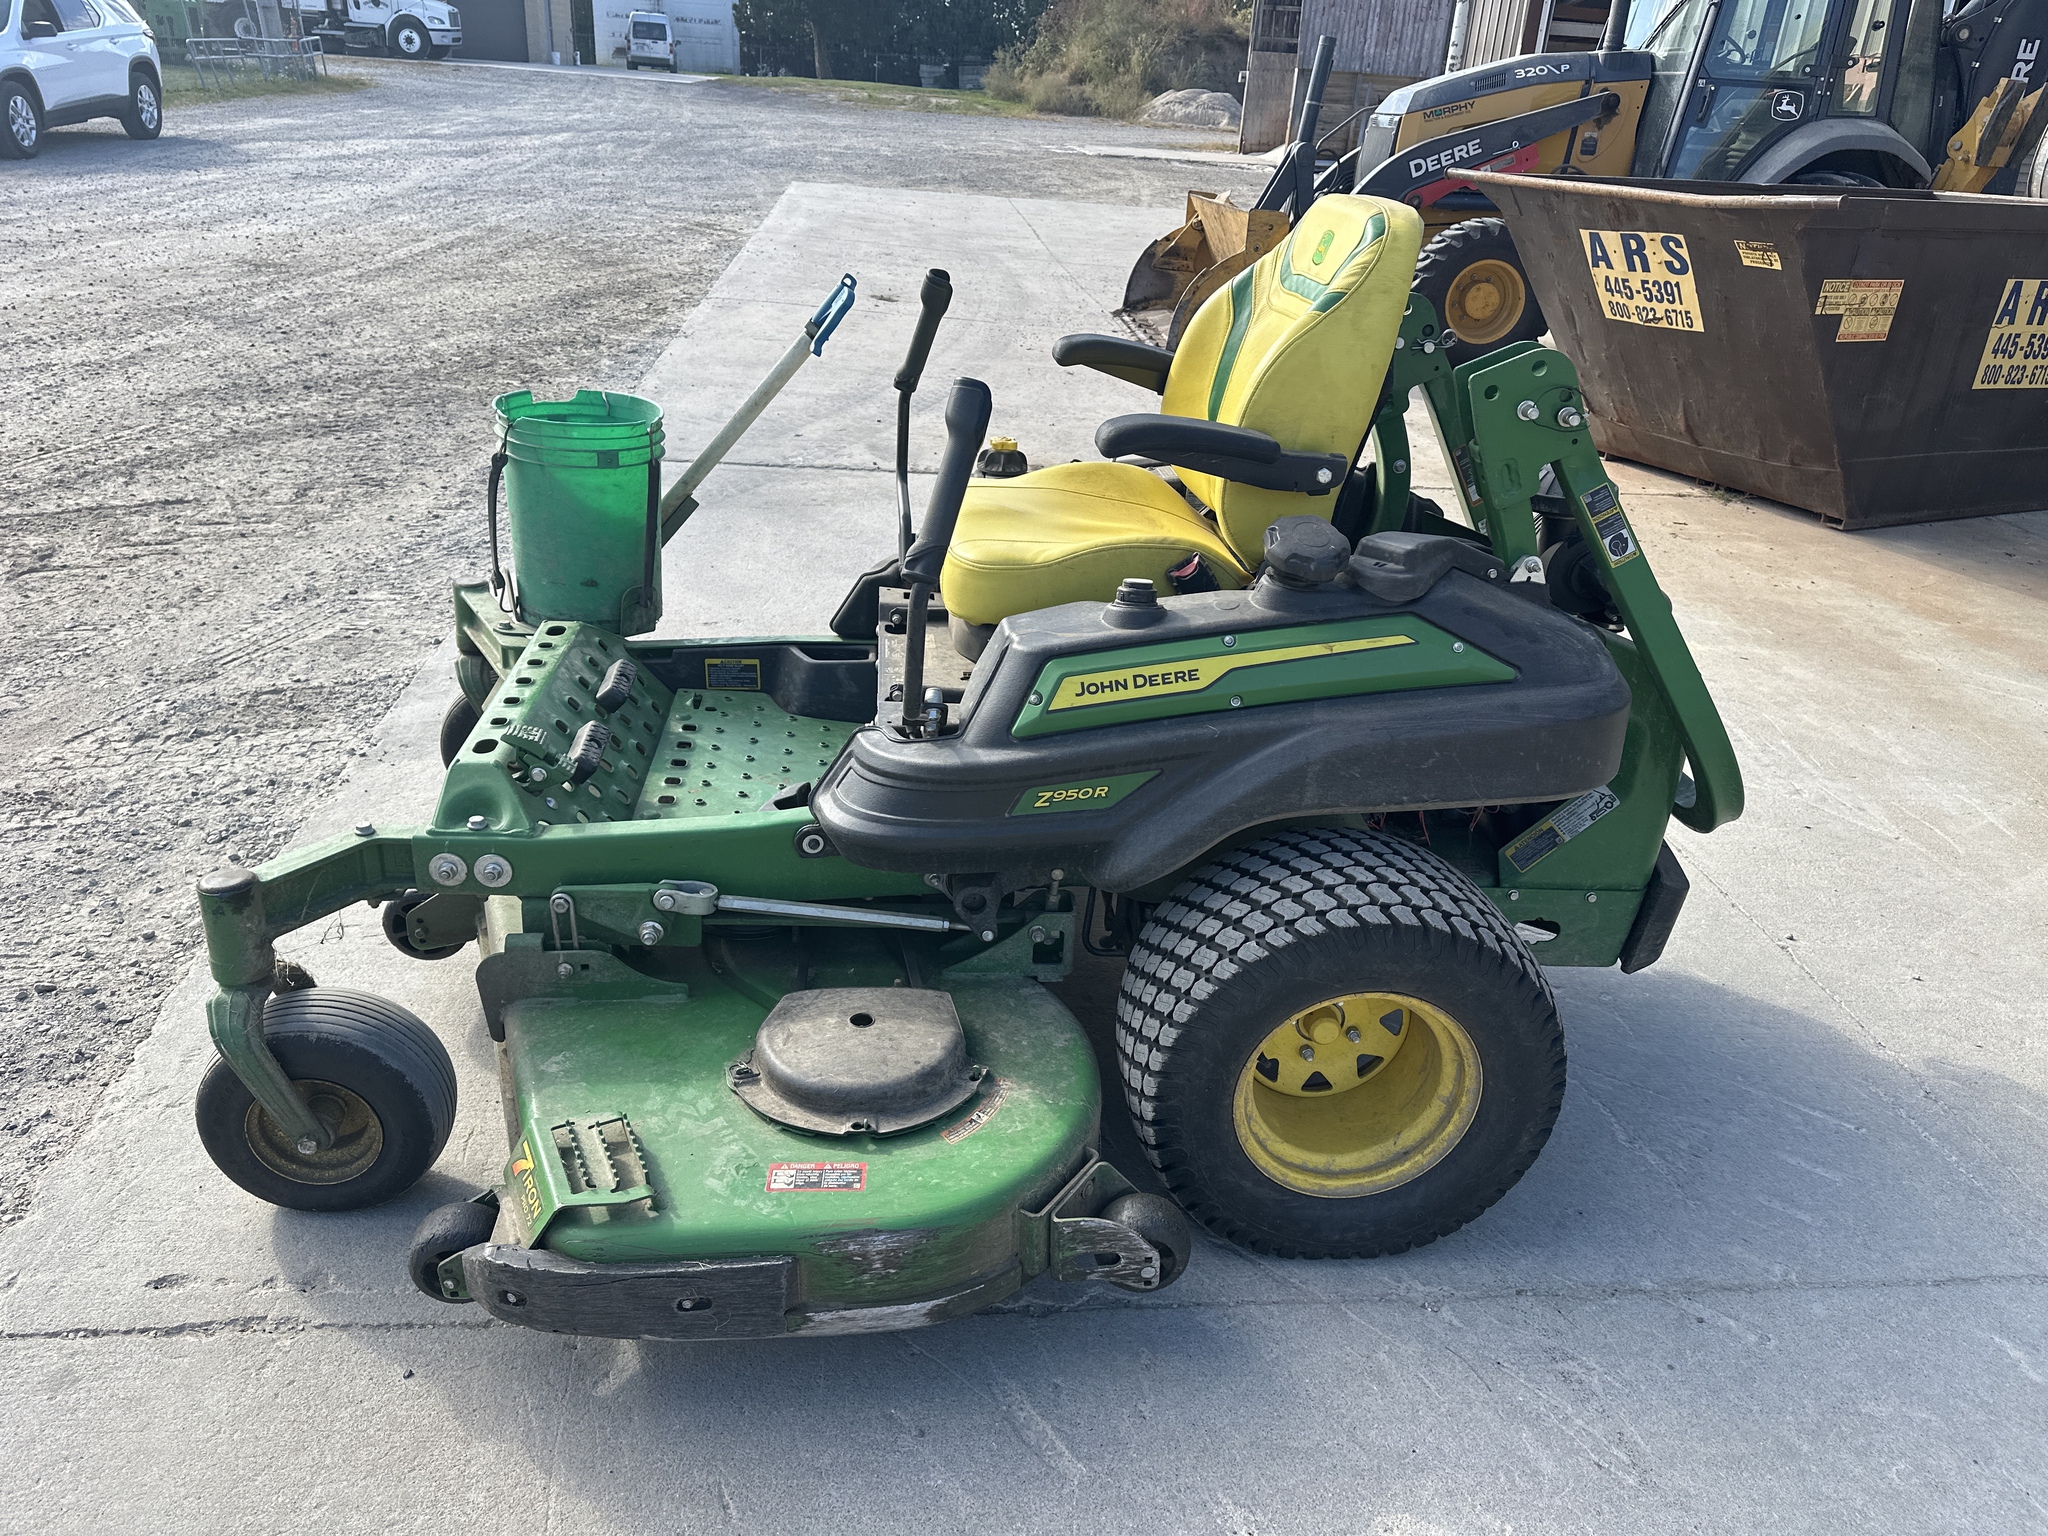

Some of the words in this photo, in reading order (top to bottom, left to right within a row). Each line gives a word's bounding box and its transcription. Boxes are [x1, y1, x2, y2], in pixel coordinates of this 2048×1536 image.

[1423, 101, 1476, 120] MURPHY
[1409, 139, 1483, 179] DEERE
[1604, 275, 1683, 305] 445-5391
[1824, 282, 1850, 292] NOTICE
[1075, 678, 1128, 697] JOHN
[1133, 668, 1200, 689] DEERE
[1034, 786, 1109, 808] Z950R
